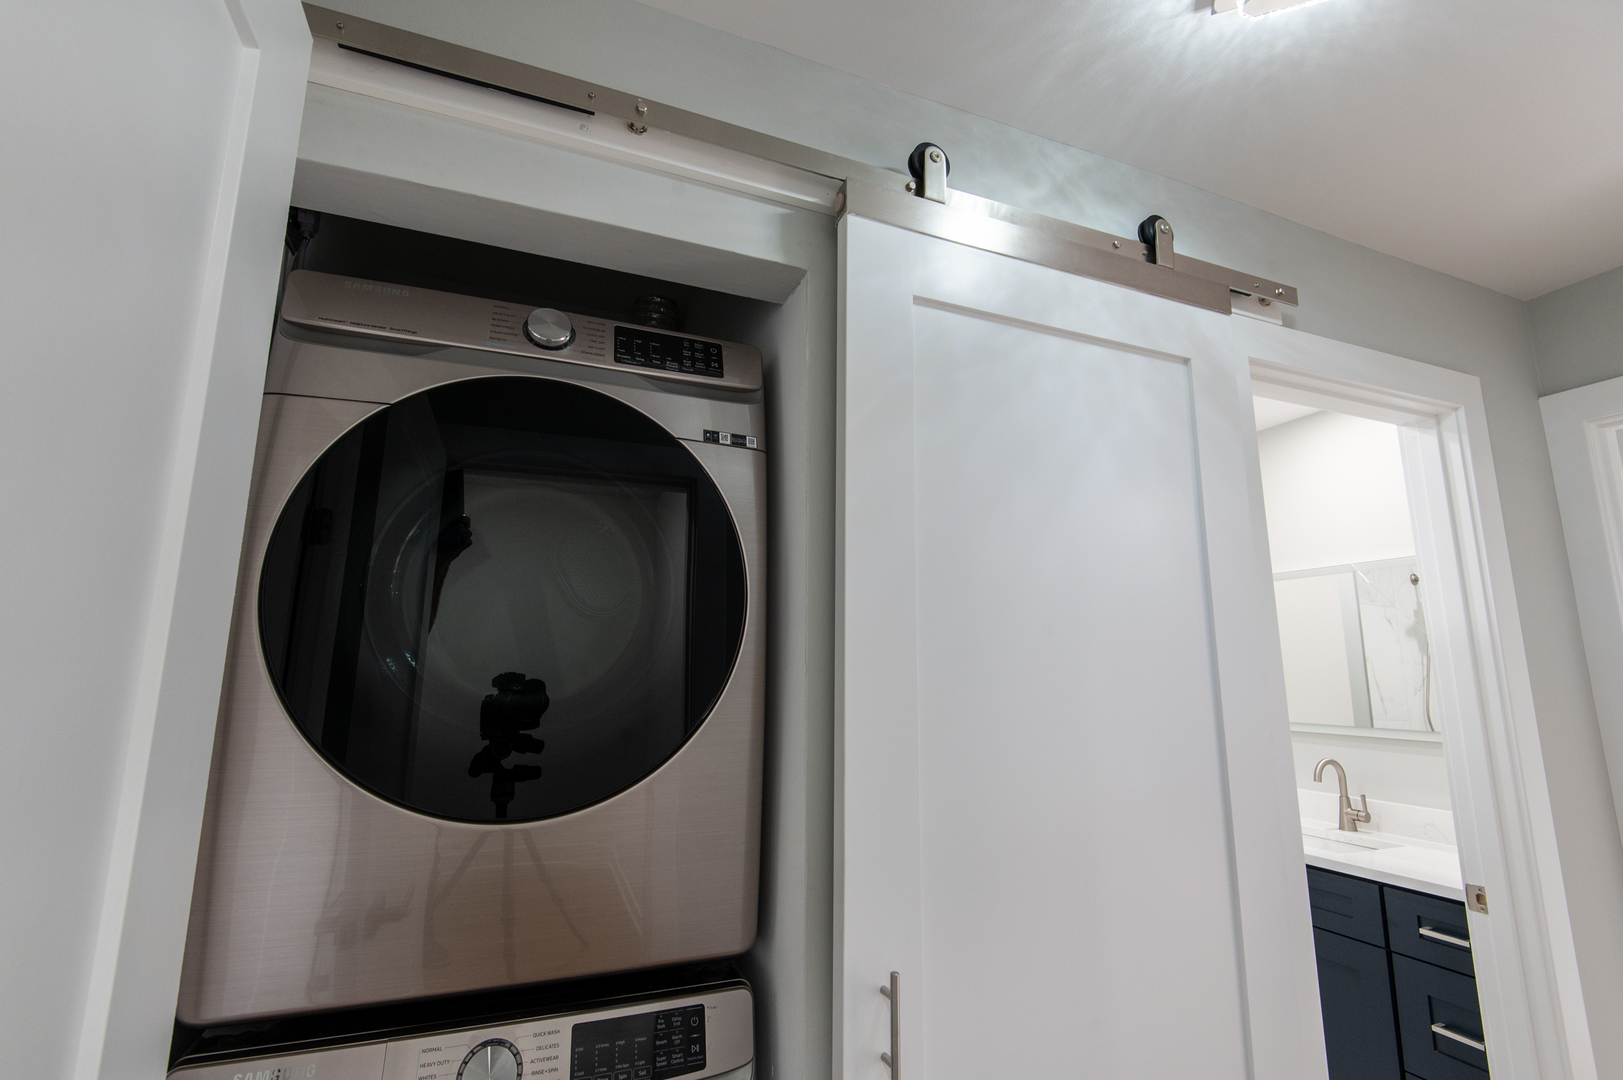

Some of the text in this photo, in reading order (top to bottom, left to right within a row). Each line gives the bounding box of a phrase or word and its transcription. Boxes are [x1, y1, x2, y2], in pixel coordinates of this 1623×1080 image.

[344, 281, 409, 297] SAMSUNG
[536, 1043, 560, 1051] DELICATES
[530, 1055, 559, 1064] ACTIVEWEAR
